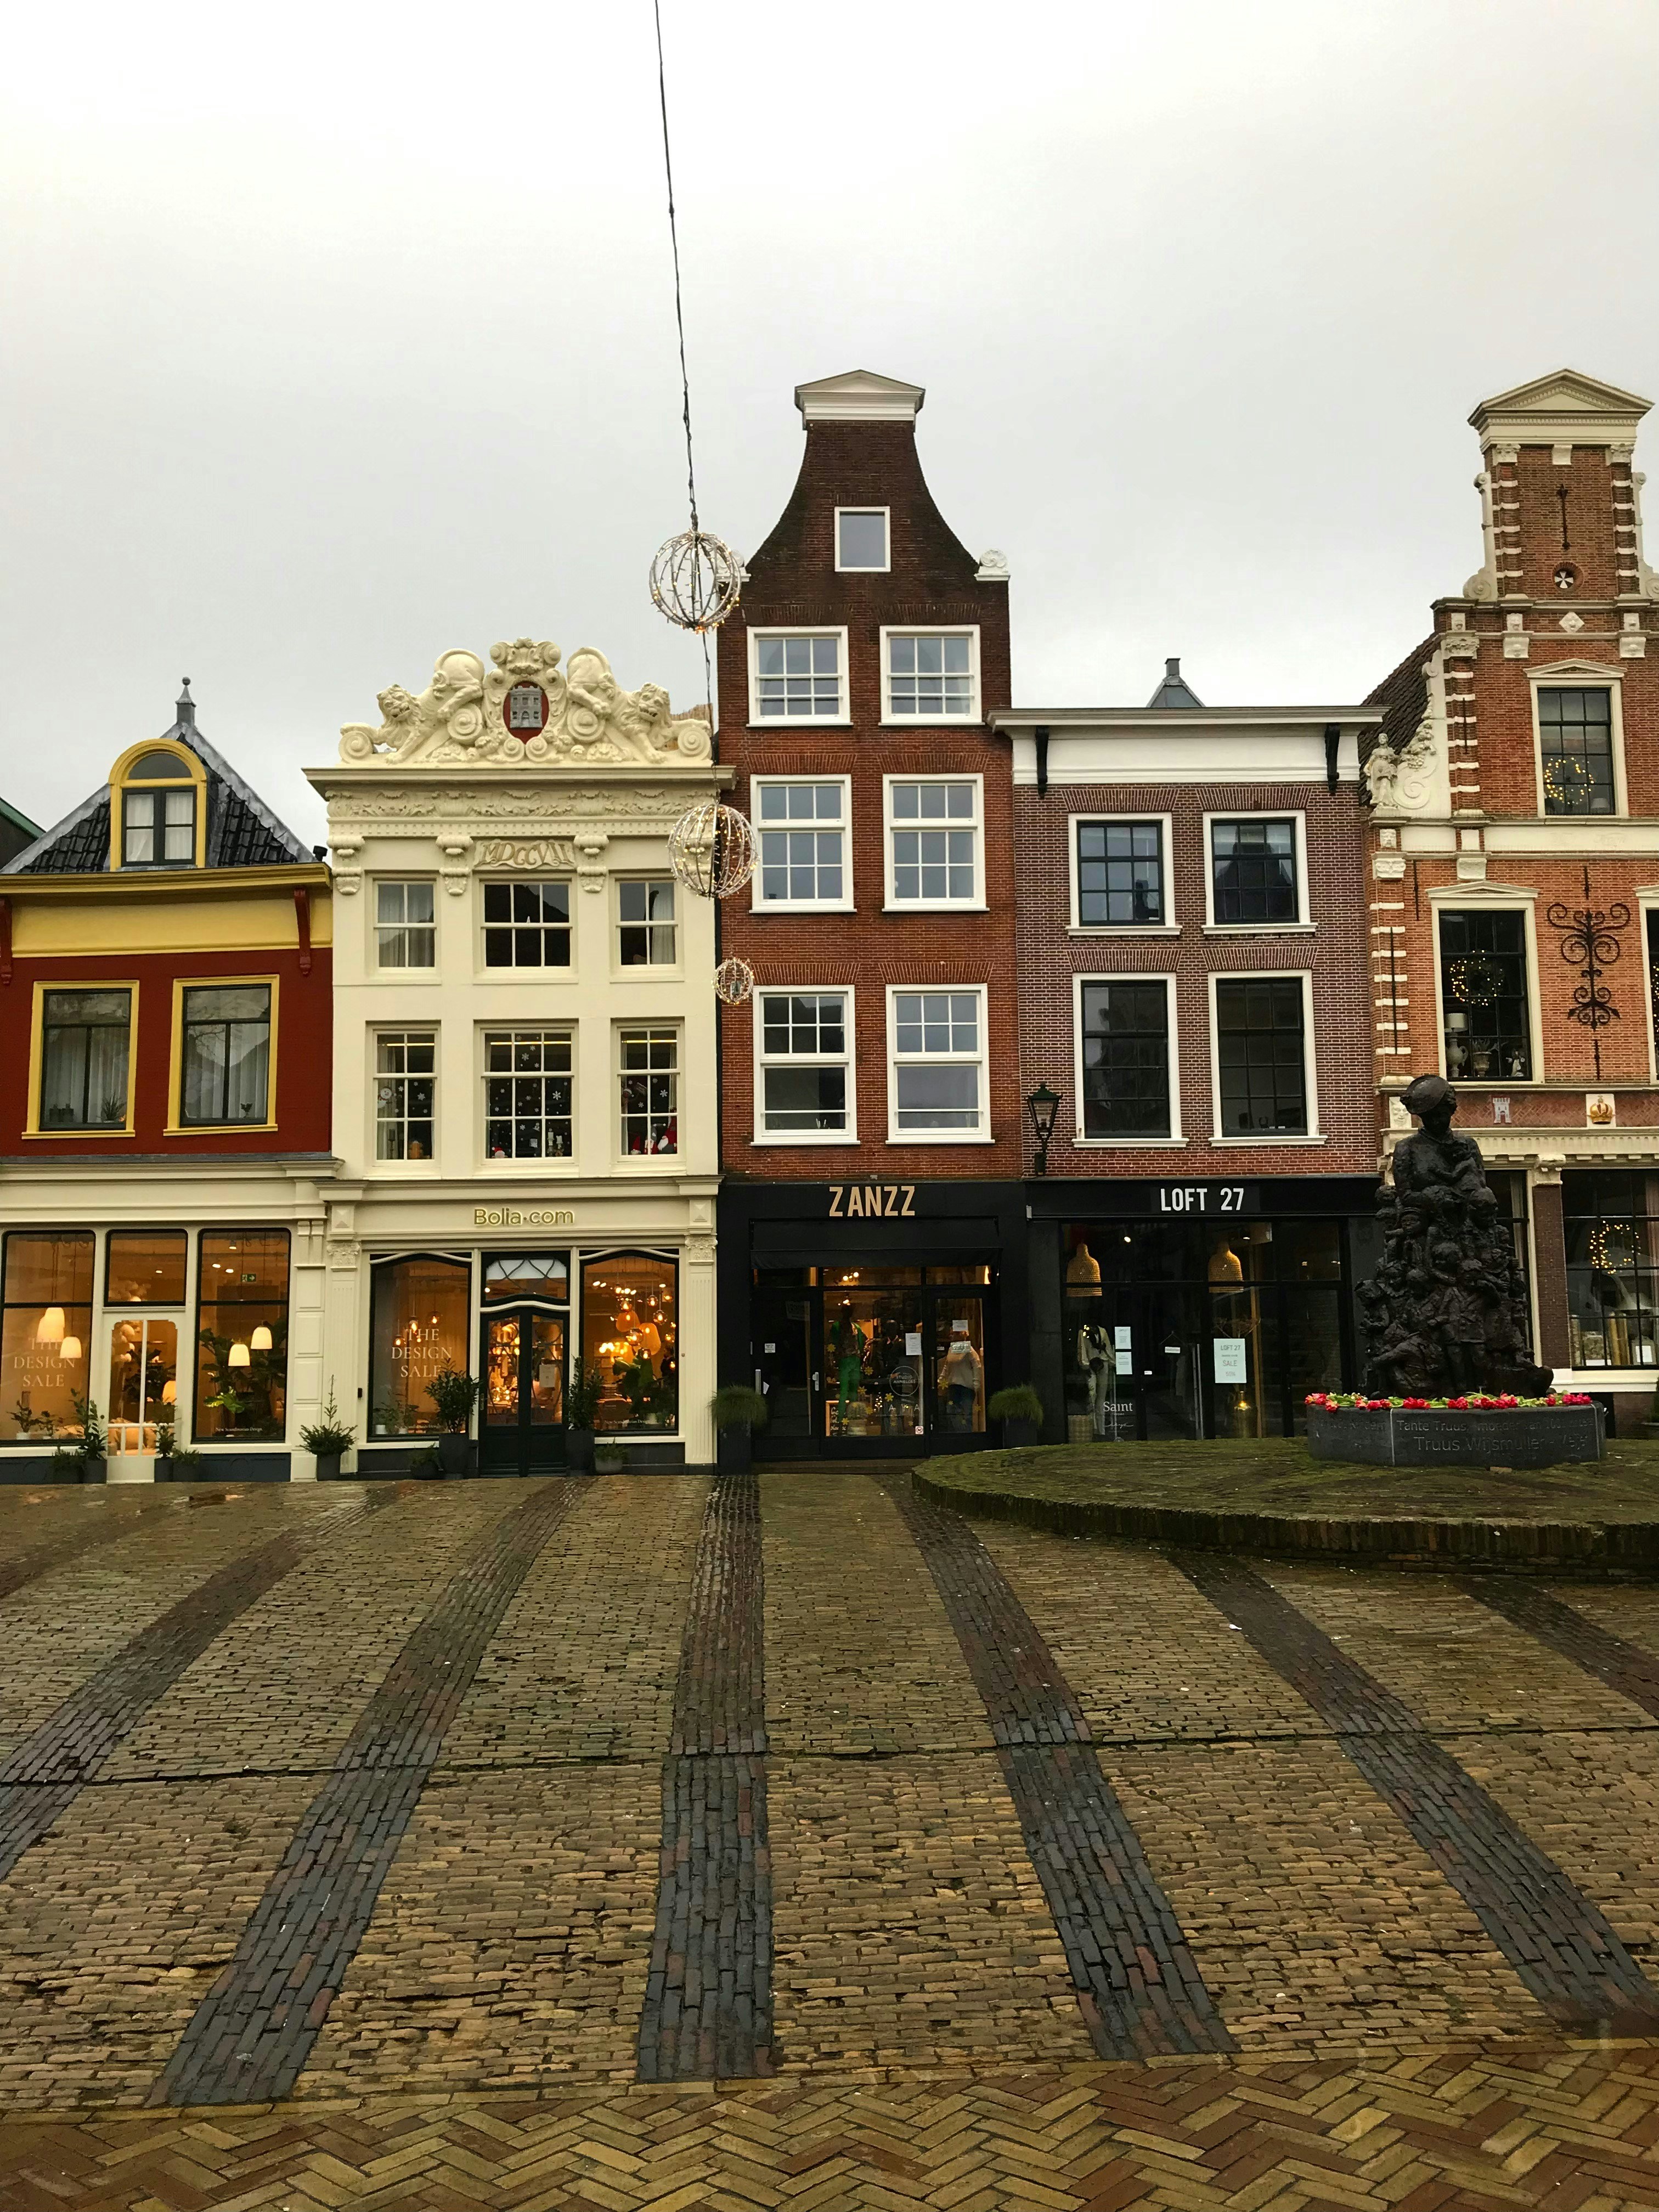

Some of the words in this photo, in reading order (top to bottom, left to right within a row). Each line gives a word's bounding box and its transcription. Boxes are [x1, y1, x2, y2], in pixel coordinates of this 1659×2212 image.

[829, 1186, 915, 1217] ZANZZ
[1160, 1188, 1207, 1211] LOFT
[1220, 1187, 1244, 1210] 27
[405, 1328, 439, 1340] THE
[392, 1347, 452, 1359] DESIGN
[14, 1356, 76, 1368] DESIGN
[22, 1374, 65, 1387] SALE
[1103, 1401, 1133, 1412] Saint
[1396, 1420, 1430, 1431] Tante
[1413, 1436, 1461, 1451] Truus
